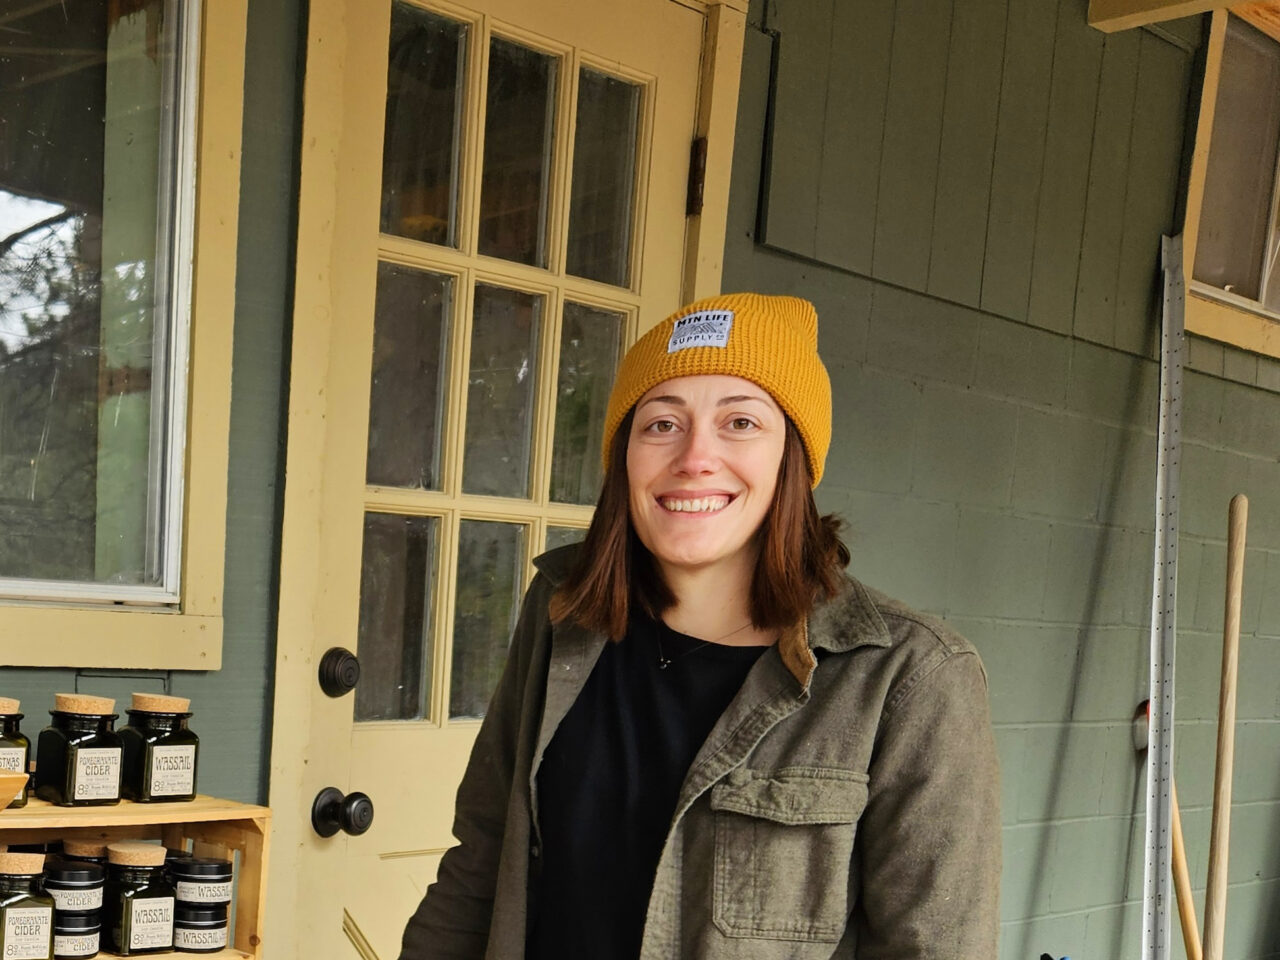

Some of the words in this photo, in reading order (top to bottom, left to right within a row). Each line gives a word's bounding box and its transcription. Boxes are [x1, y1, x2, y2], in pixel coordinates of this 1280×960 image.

[678, 316, 701, 327] MTN
[673, 335, 713, 345] SUPPLY
[80, 756, 118, 765] POMEGRANATE
[156, 756, 191, 771] WASSAIL
[85, 765, 110, 776] CIDER
[9, 916, 49, 925] POMEGRANATE
[134, 908, 170, 924] WASSAIL
[14, 926, 41, 936] CIDER
[183, 931, 219, 944] WASSAIL
